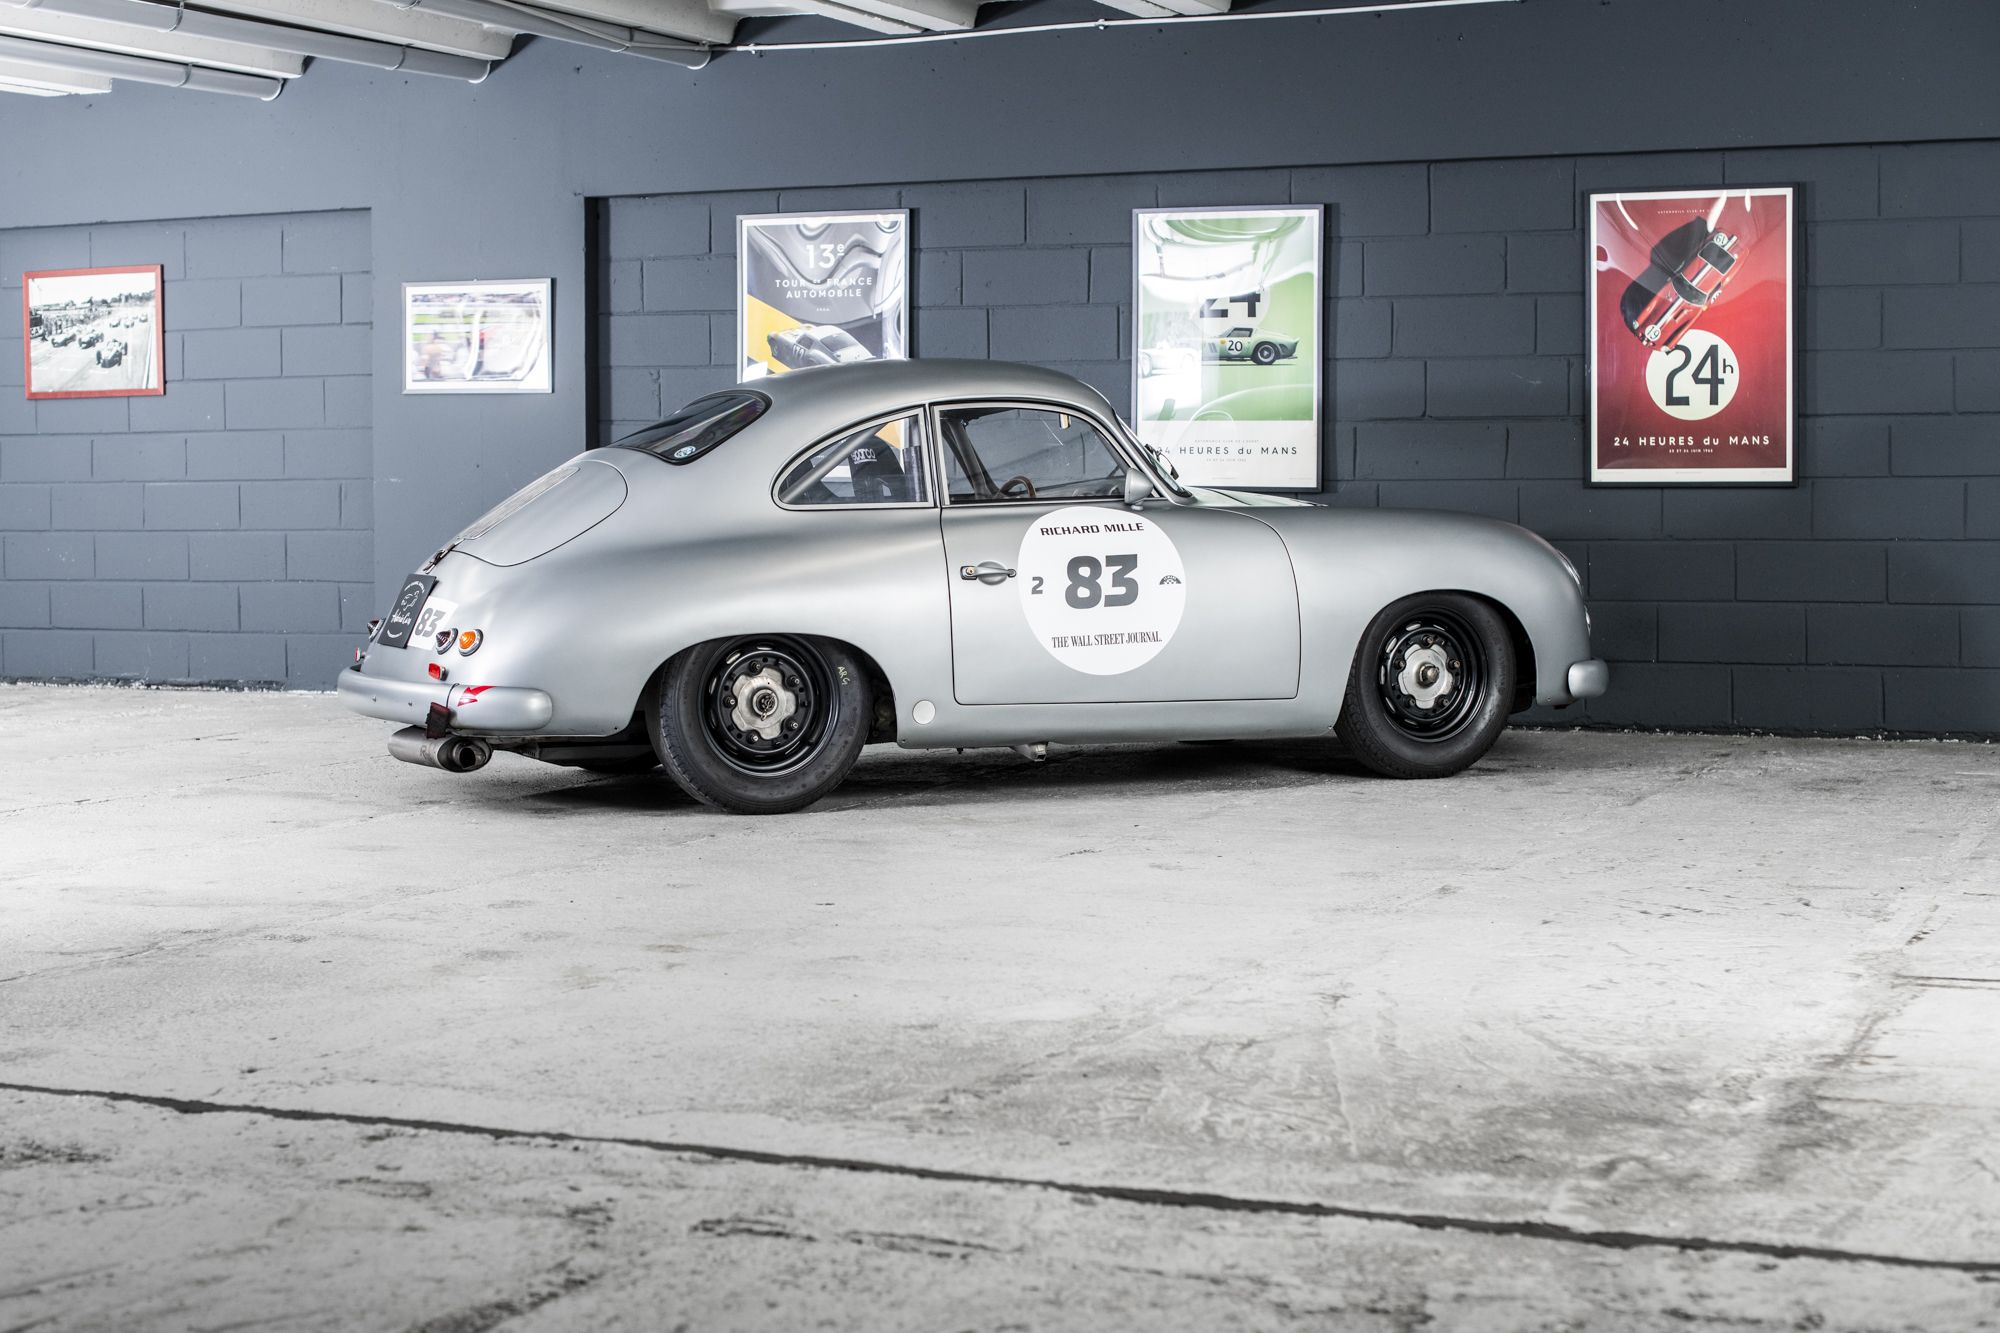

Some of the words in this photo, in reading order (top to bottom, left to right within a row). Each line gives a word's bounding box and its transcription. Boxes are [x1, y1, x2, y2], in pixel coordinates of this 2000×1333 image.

[775, 279, 806, 288] TOUR
[827, 276, 873, 287] FRANCE
[786, 288, 862, 299] AUTOMOBILE
[1228, 340, 1243, 352] 20
[1614, 436, 1629, 446] 24
[1639, 436, 1694, 446] HEURES
[1703, 436, 1719, 445] du
[1729, 435, 1770, 445] MANS
[1179, 446, 1229, 455] HEURES
[1237, 446, 1252, 455] du
[1260, 446, 1297, 455] MANS
[1040, 524, 1100, 536] RICHARD
[1104, 522, 1144, 533] MILLE
[1031, 576, 1044, 595] 2
[1065, 553, 1139, 610] 83
[414, 607, 446, 637] 83
[1051, 636, 1069, 649] THE
[1071, 634, 1093, 647] WALL
[1094, 632, 1124, 646] STREET
